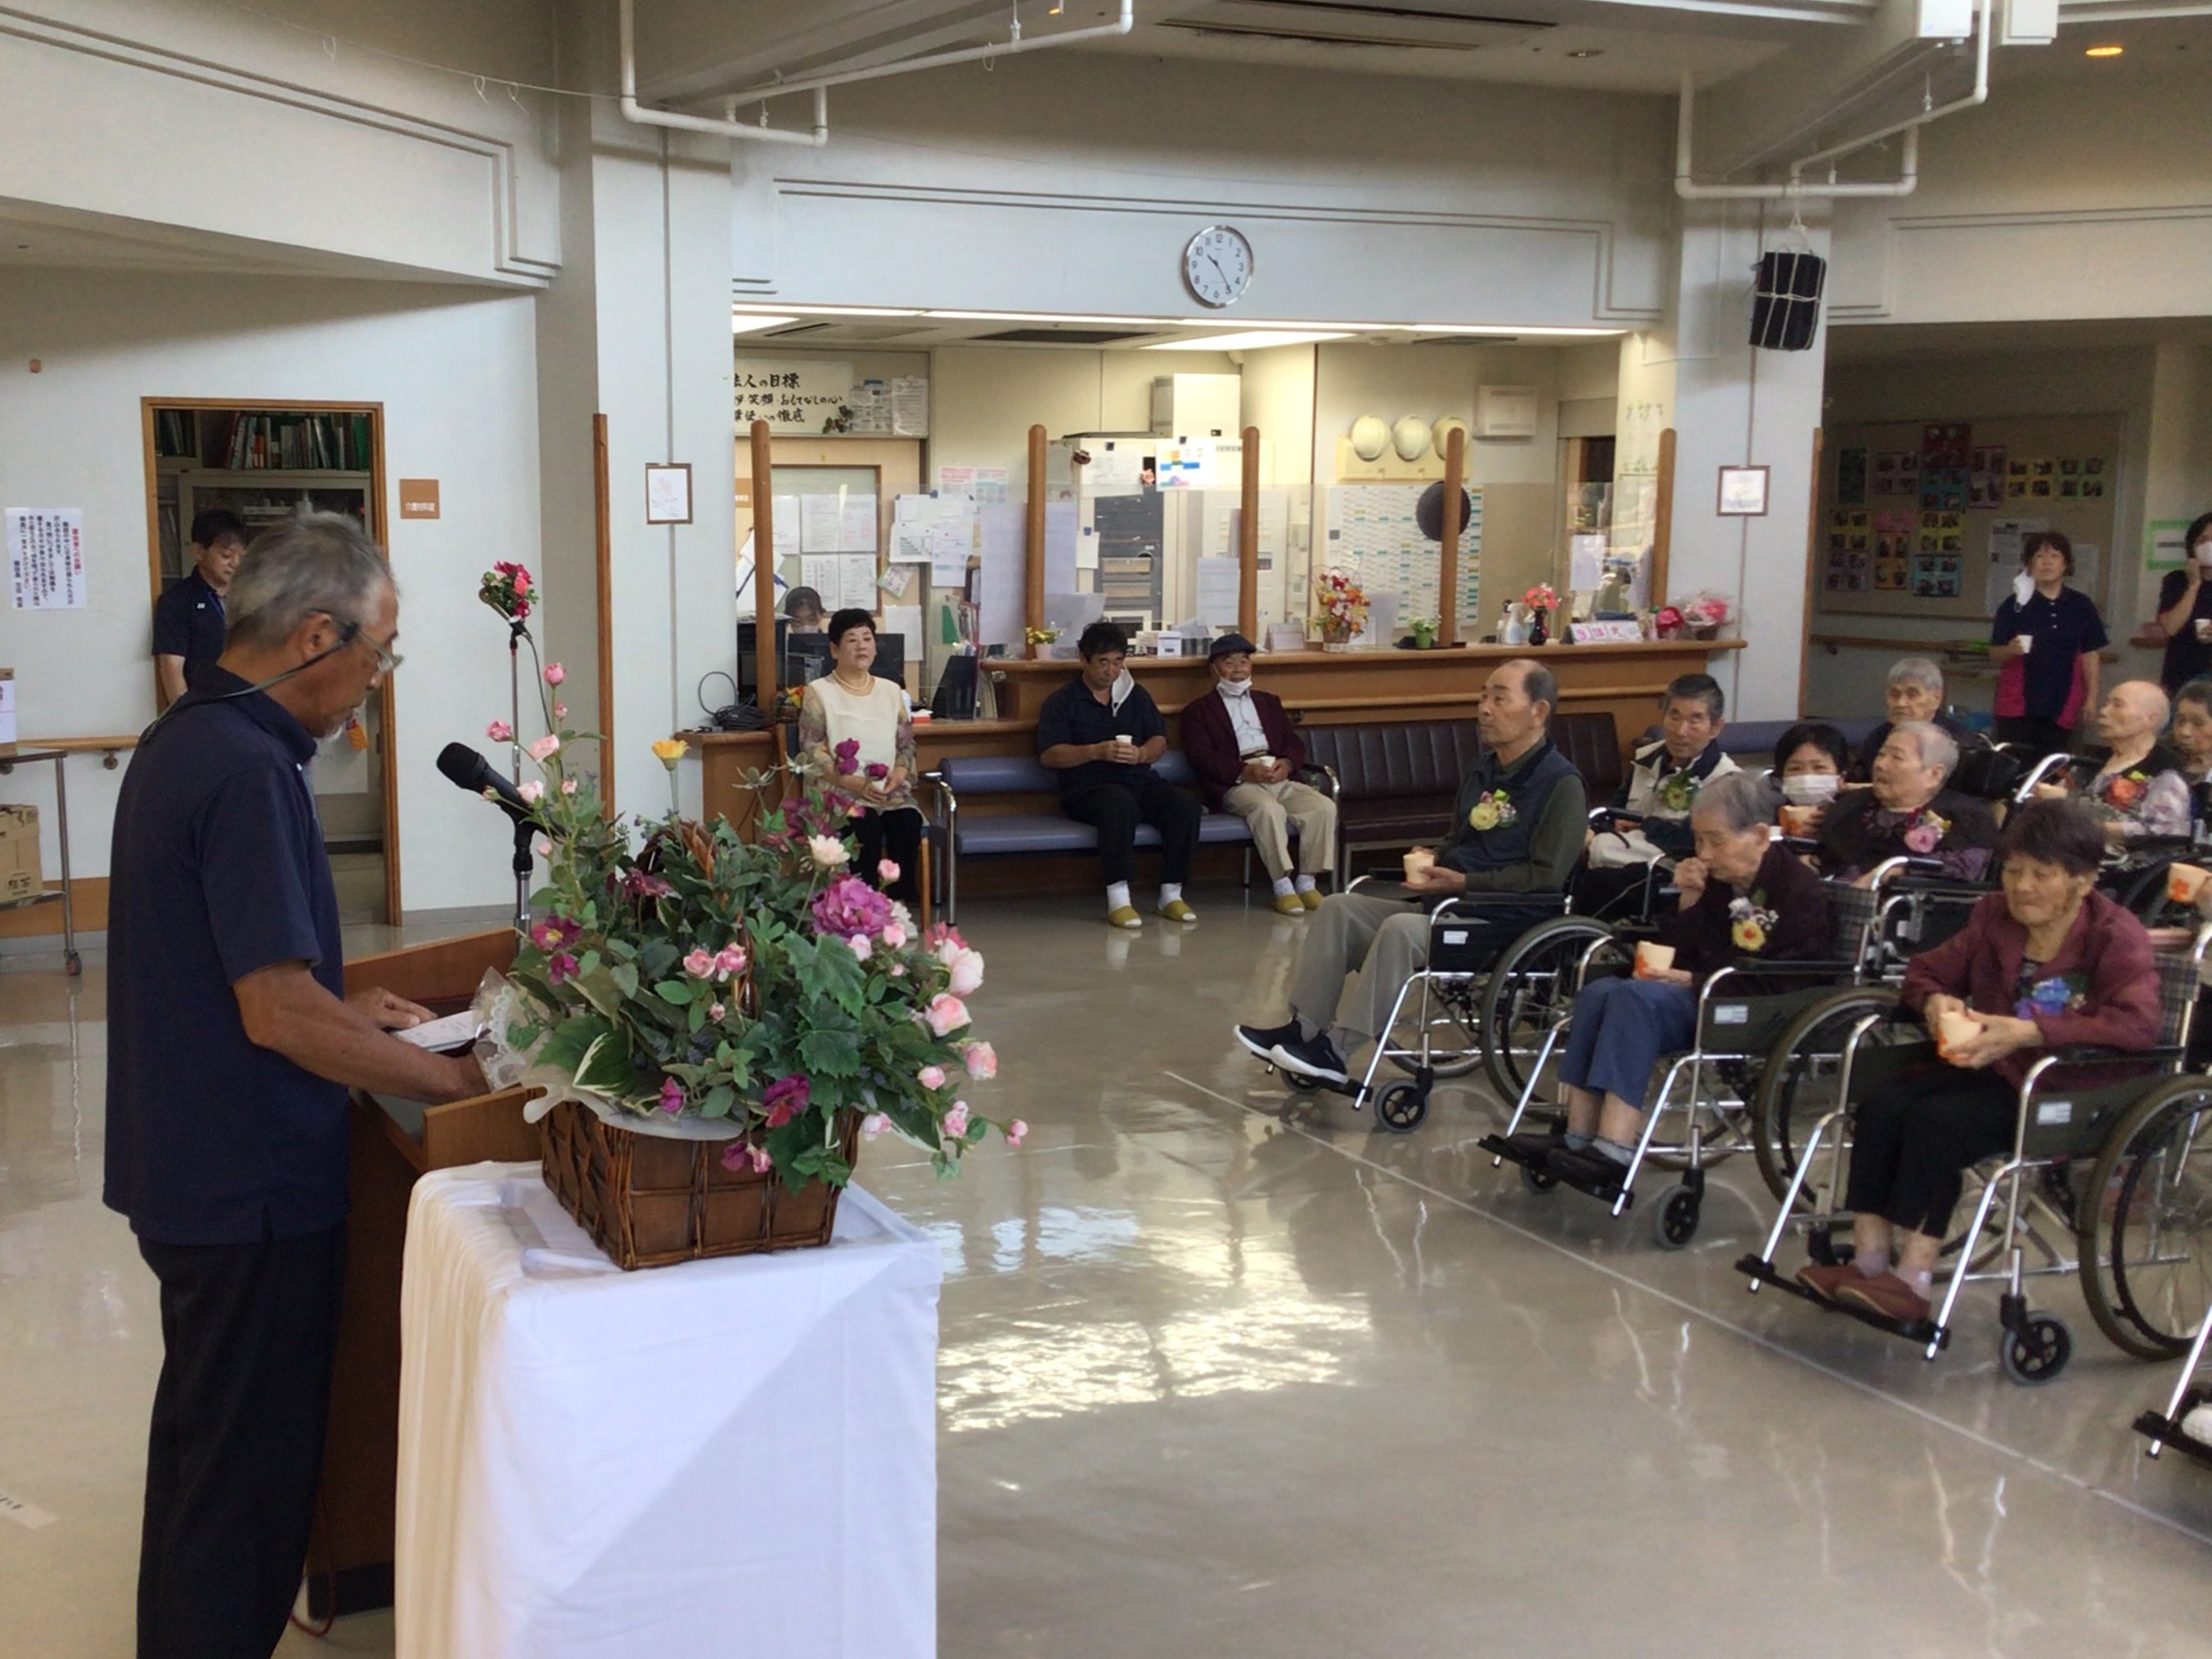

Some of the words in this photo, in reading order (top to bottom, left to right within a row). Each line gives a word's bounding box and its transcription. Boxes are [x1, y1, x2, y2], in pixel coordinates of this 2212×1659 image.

[1216, 233, 1223, 243] 12
[1229, 238, 1232, 247] 1
[1195, 246, 1203, 256] 10
[1235, 248, 1242, 258] 2
[1191, 260, 1198, 270] 9
[1239, 262, 1244, 272] 3
[1194, 275, 1200, 285] 8
[1234, 276, 1241, 285] 4
[1203, 285, 1208, 294] 7
[1213, 289, 1220, 299] 6
